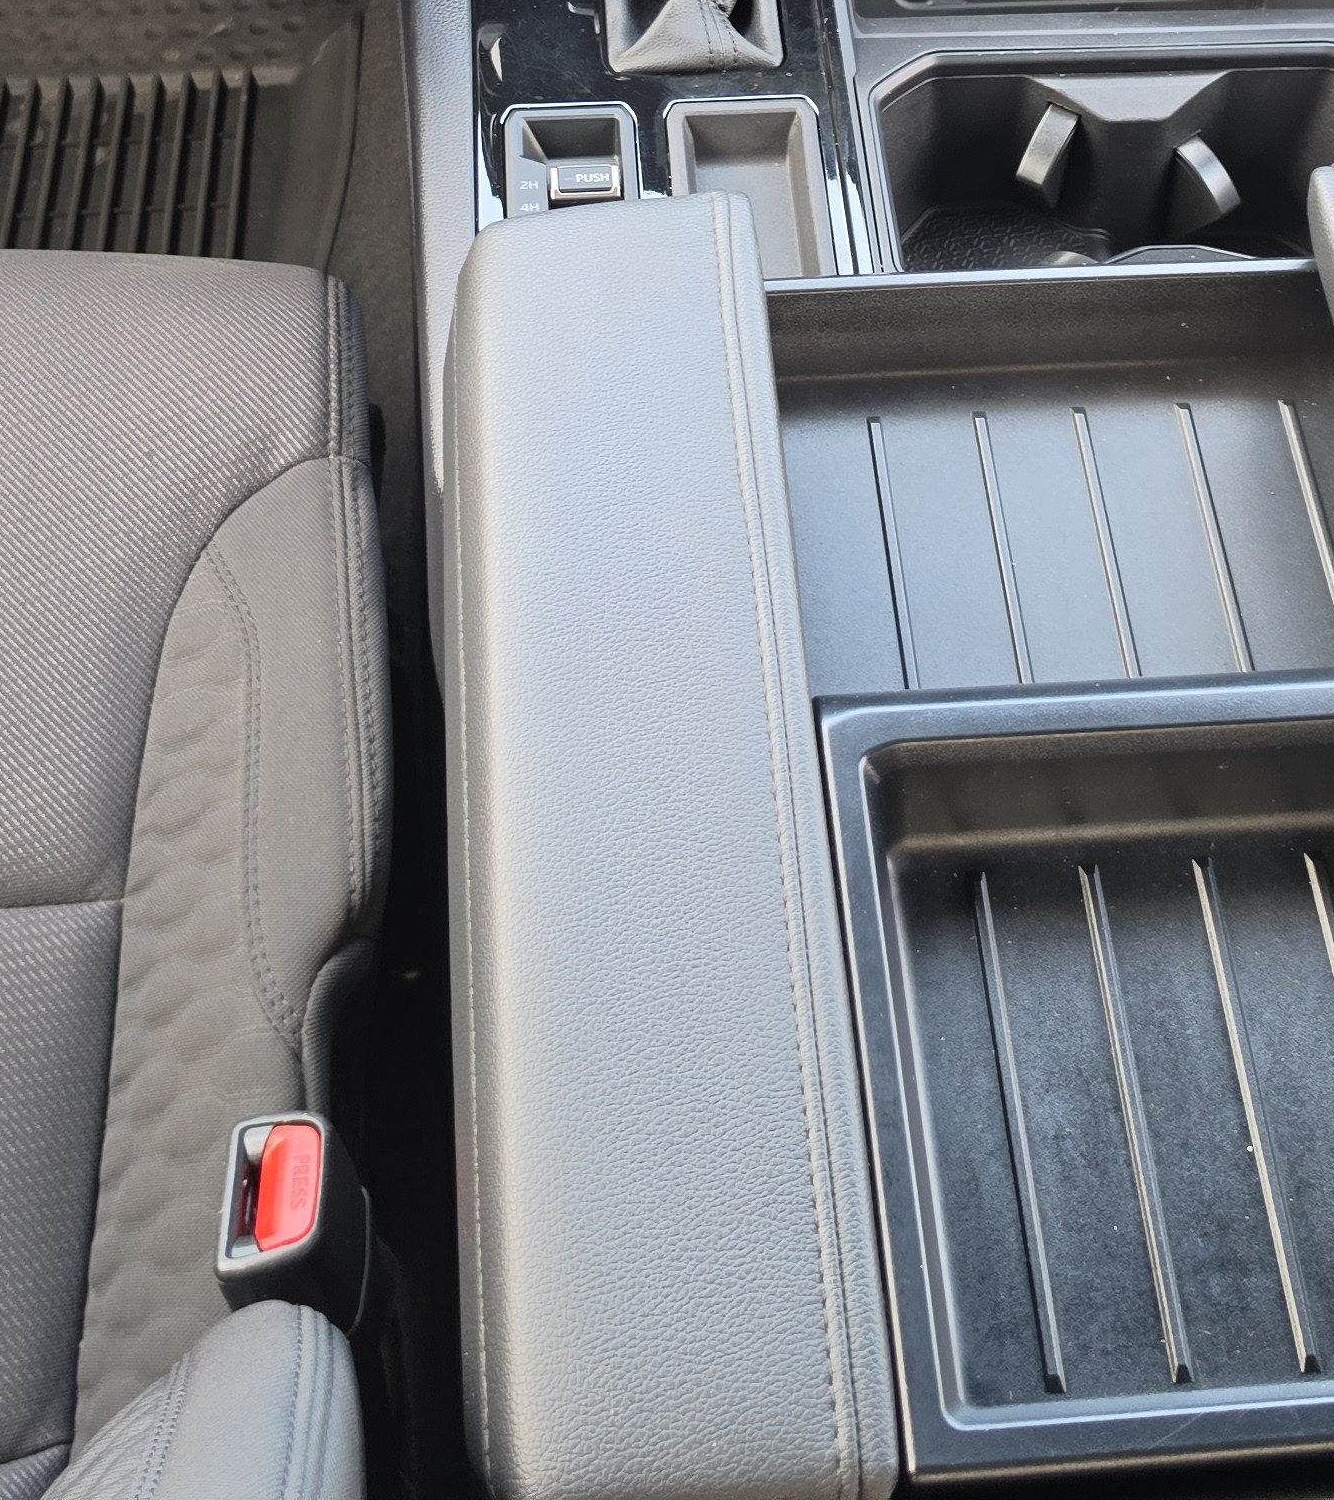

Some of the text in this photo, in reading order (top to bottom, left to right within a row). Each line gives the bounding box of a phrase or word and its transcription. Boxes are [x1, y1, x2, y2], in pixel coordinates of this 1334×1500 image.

[575, 171, 610, 184] PUSH
[519, 180, 540, 191] 2H
[519, 202, 541, 213] 4H
[290, 1153, 312, 1211] PRESS
